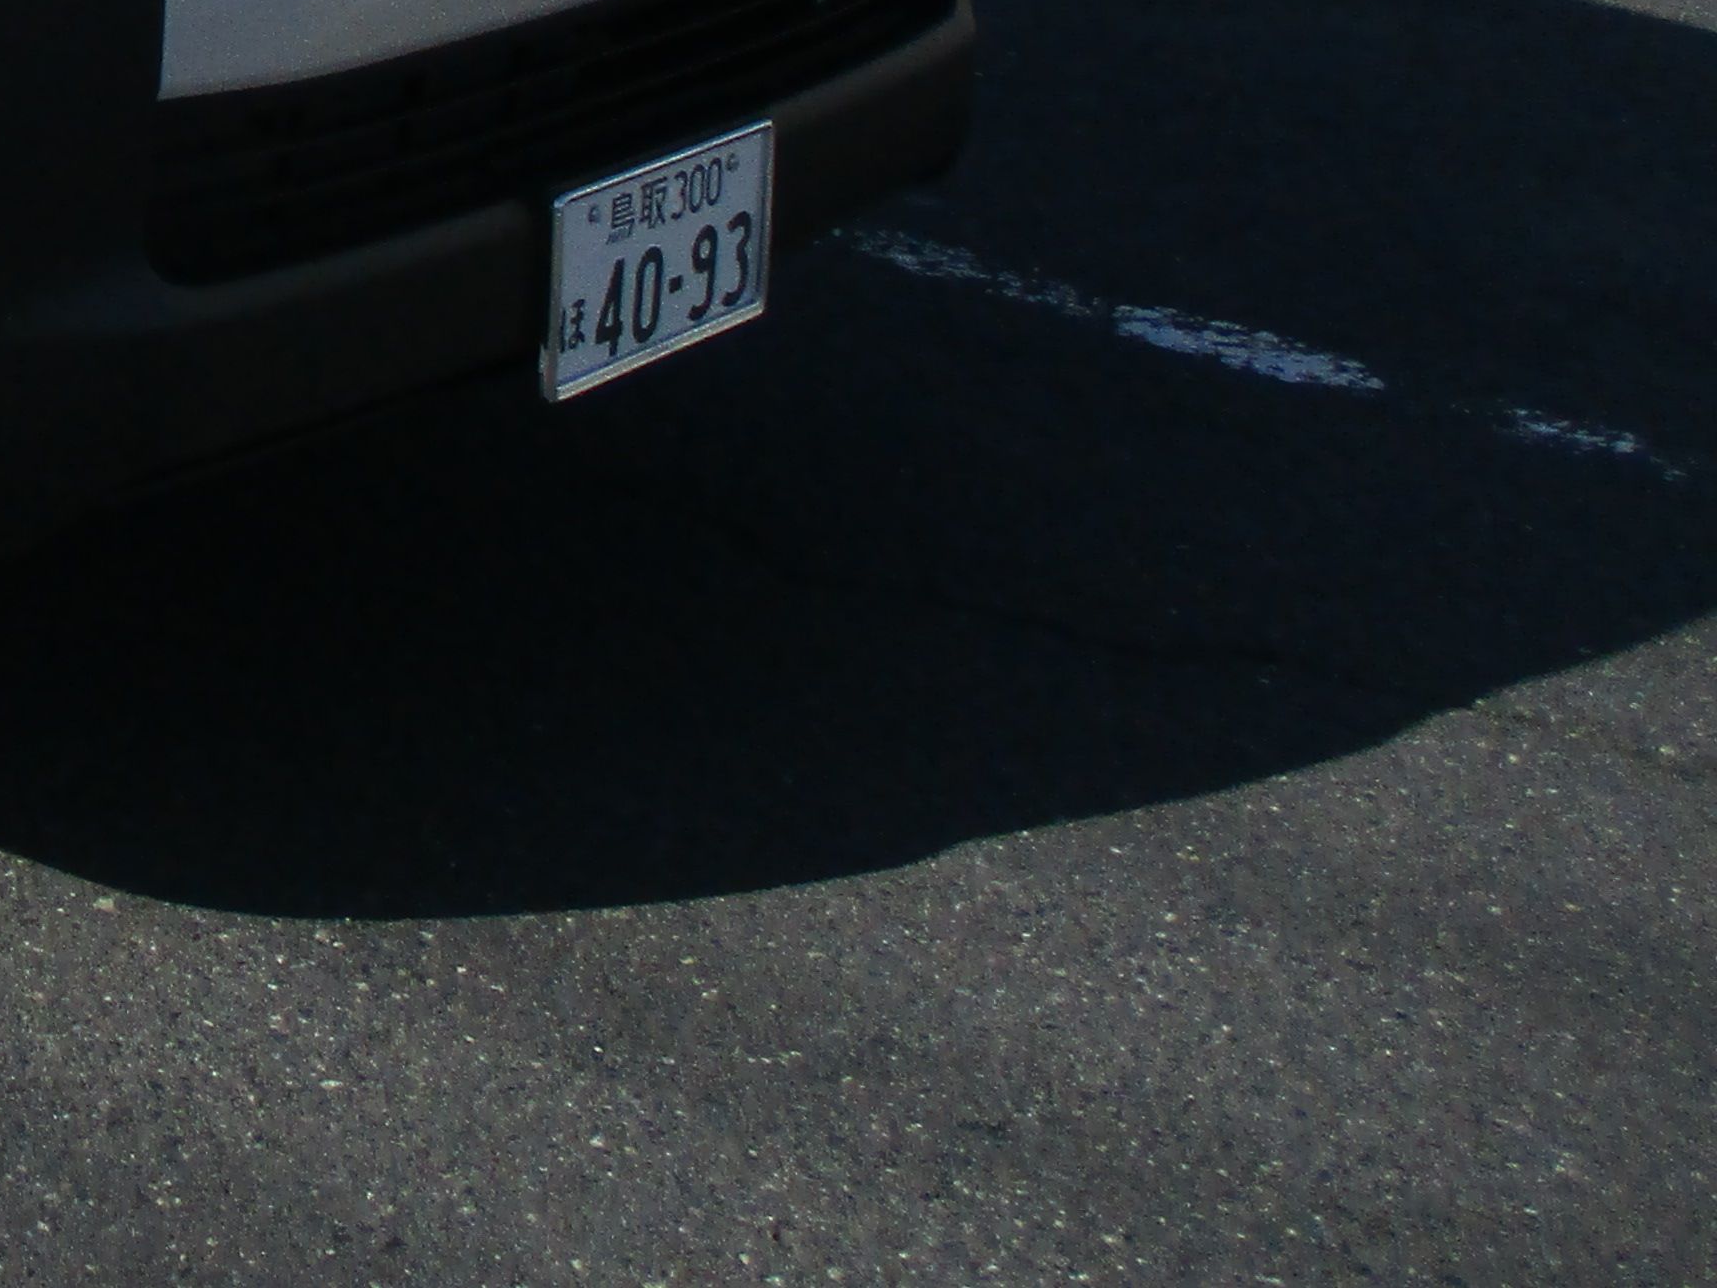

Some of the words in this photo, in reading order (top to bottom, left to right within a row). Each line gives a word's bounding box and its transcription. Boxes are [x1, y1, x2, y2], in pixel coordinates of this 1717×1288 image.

[670, 157, 722, 221] 300
[559, 298, 586, 354] ほ
[594, 210, 753, 356] 40-93
